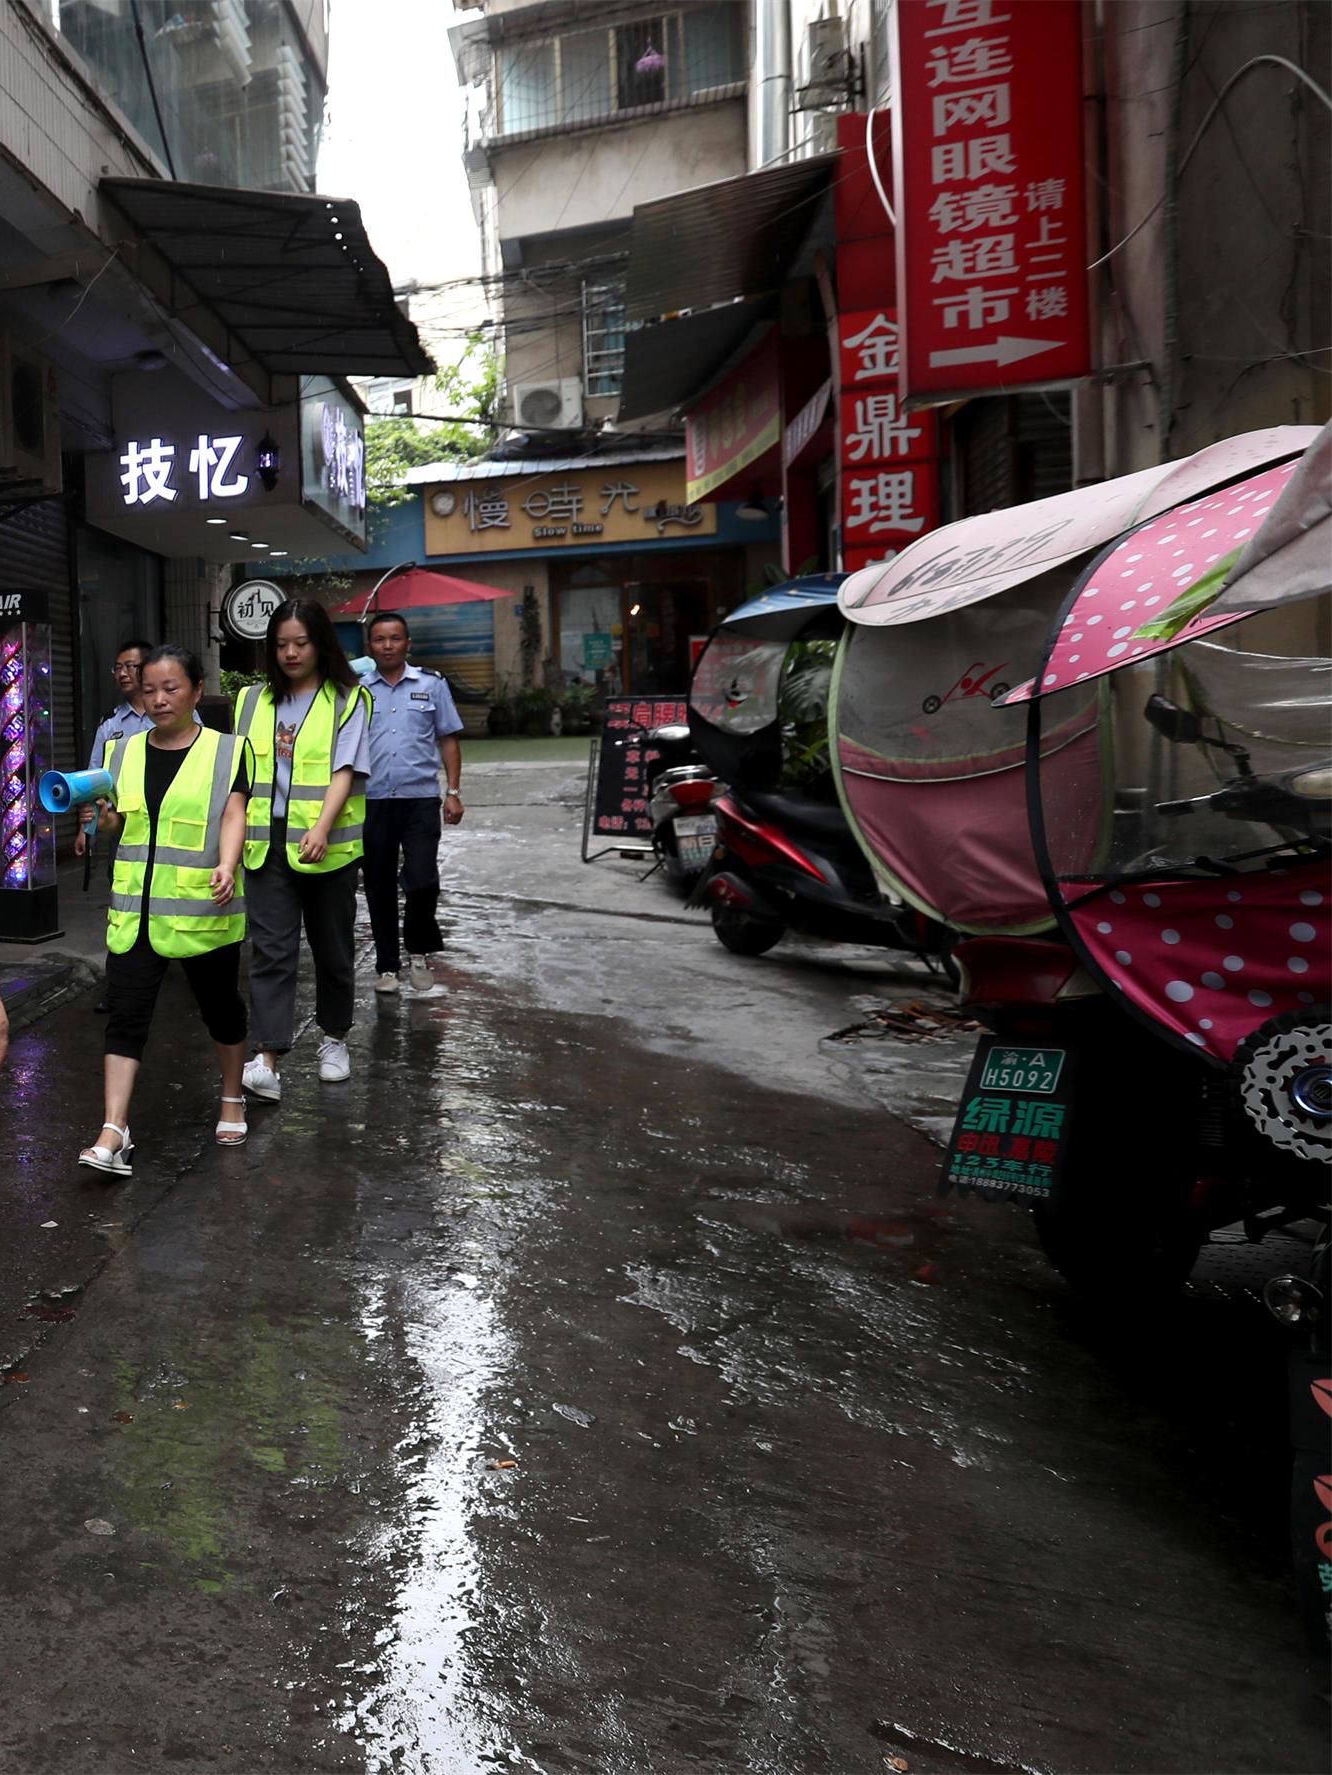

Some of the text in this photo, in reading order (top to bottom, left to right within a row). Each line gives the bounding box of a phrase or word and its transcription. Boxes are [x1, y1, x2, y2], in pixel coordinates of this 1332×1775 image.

[1023, 178, 1068, 320] 请上二楼
[843, 313, 925, 568] 金鼎理
[119, 434, 250, 505] 技忆
[533, 522, 604, 538] Slow time
[237, 601, 274, 618] 初见
[985, 1068, 1054, 1090] H5092
[961, 1096, 1069, 1140] 绿源
